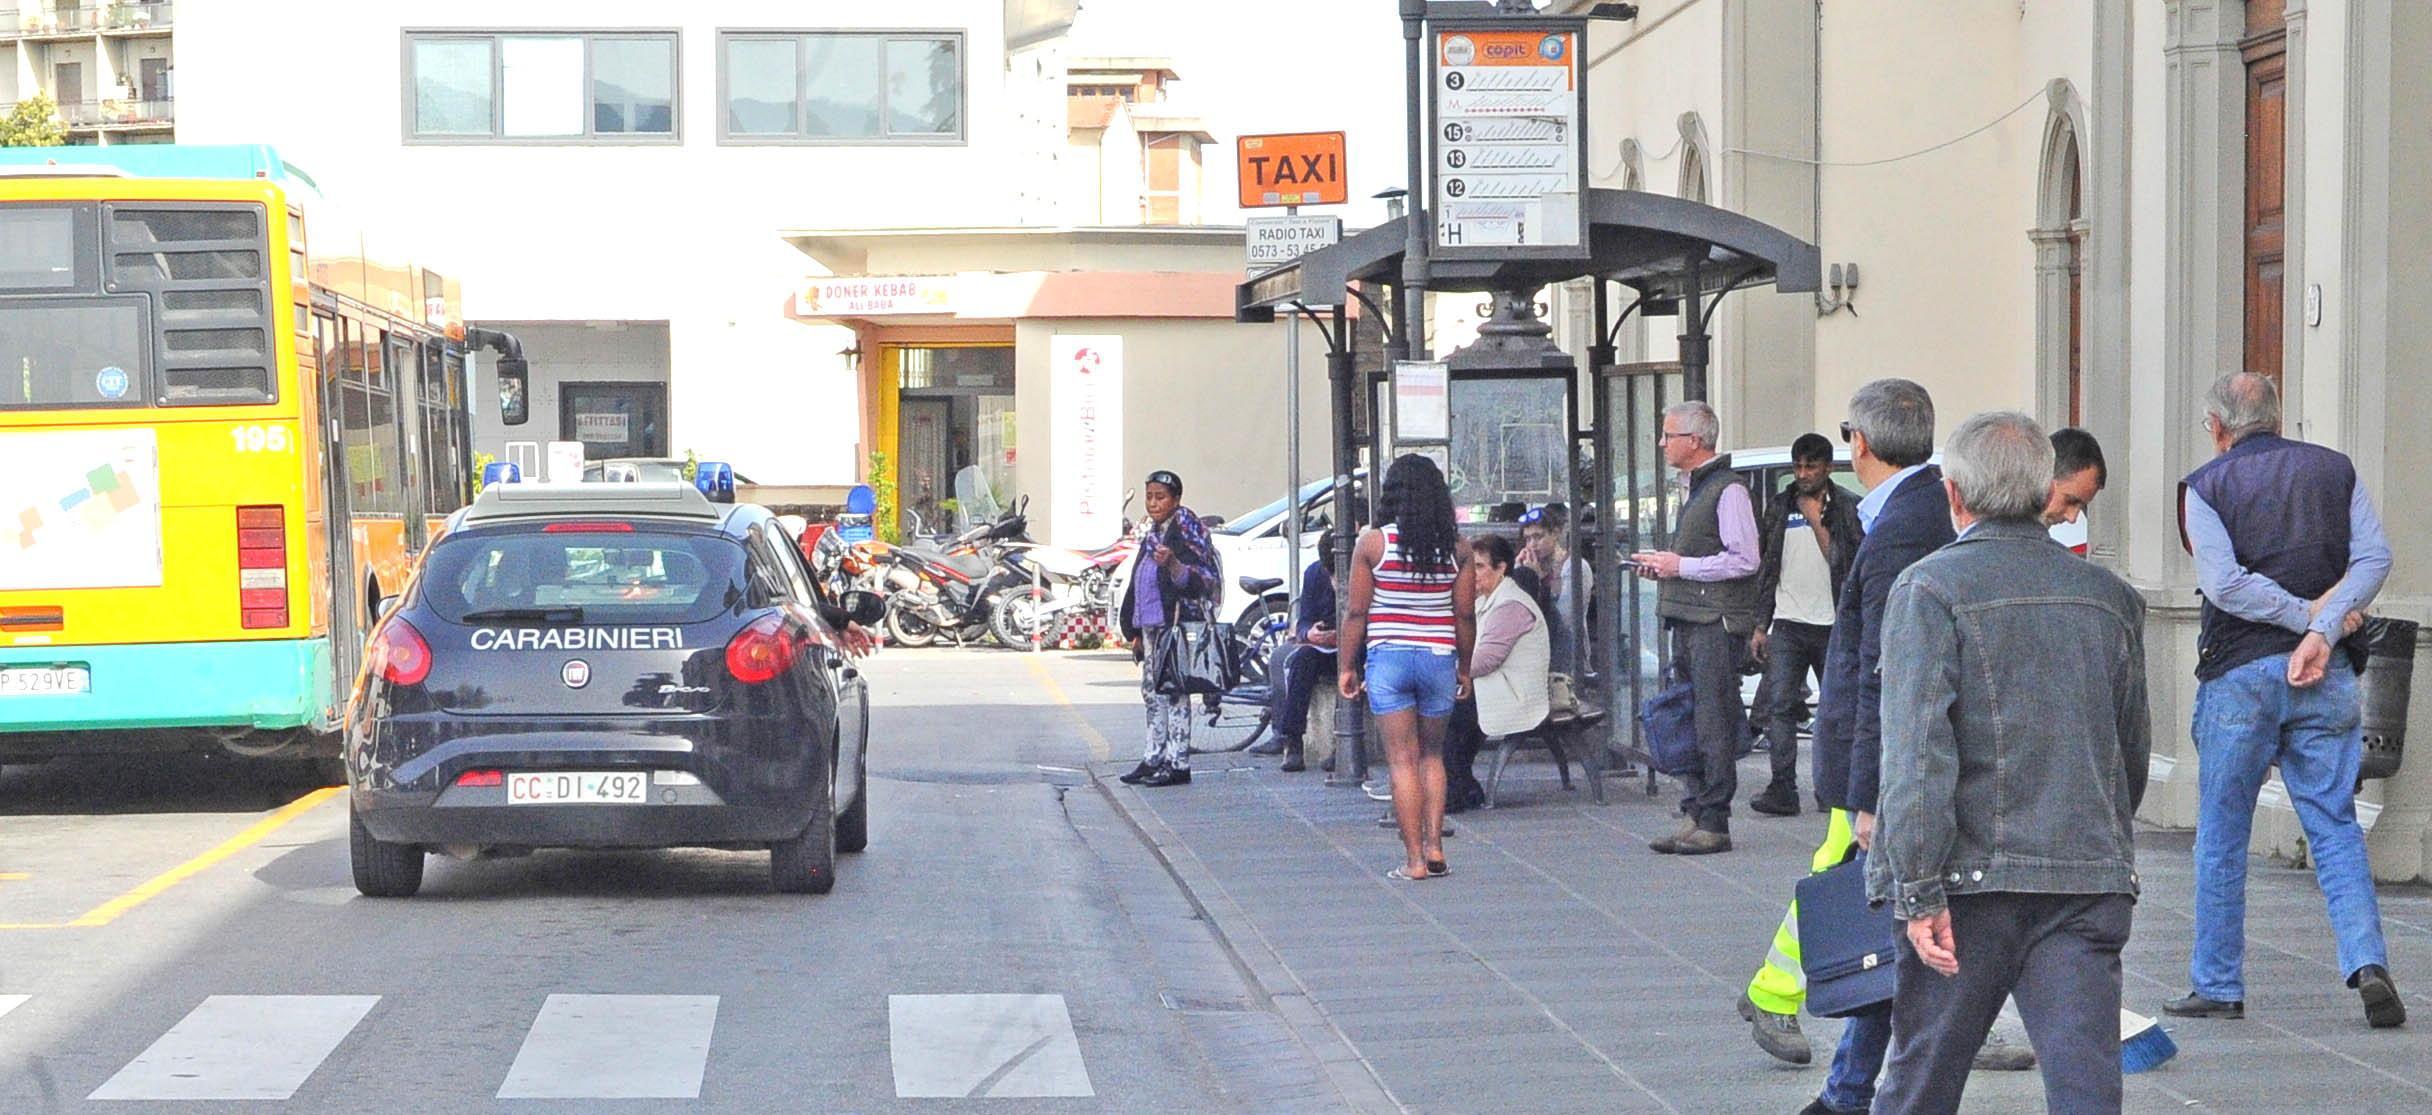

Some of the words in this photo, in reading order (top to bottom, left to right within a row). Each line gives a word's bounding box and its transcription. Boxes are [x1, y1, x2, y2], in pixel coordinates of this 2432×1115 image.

[1486, 43, 1526, 58] copit
[1450, 74, 1460, 88] 3
[1447, 126, 1461, 139] 15
[1449, 152, 1463, 165] 13
[1248, 153, 1337, 186] TAXI
[1449, 182, 1463, 195] 12
[1259, 227, 1297, 241] RADIO
[1300, 226, 1325, 240] TAXI
[1251, 244, 1278, 258] 0573
[1286, 244, 1300, 258] 53
[826, 284, 868, 299] DONER
[874, 283, 916, 297] KEBAB
[231, 425, 285, 452] 195
[470, 628, 683, 650] CARABINIERI
[19, 671, 77, 690] 529VE
[513, 776, 541, 799] CC
[557, 776, 581, 799] DI
[596, 776, 640, 799] 492
